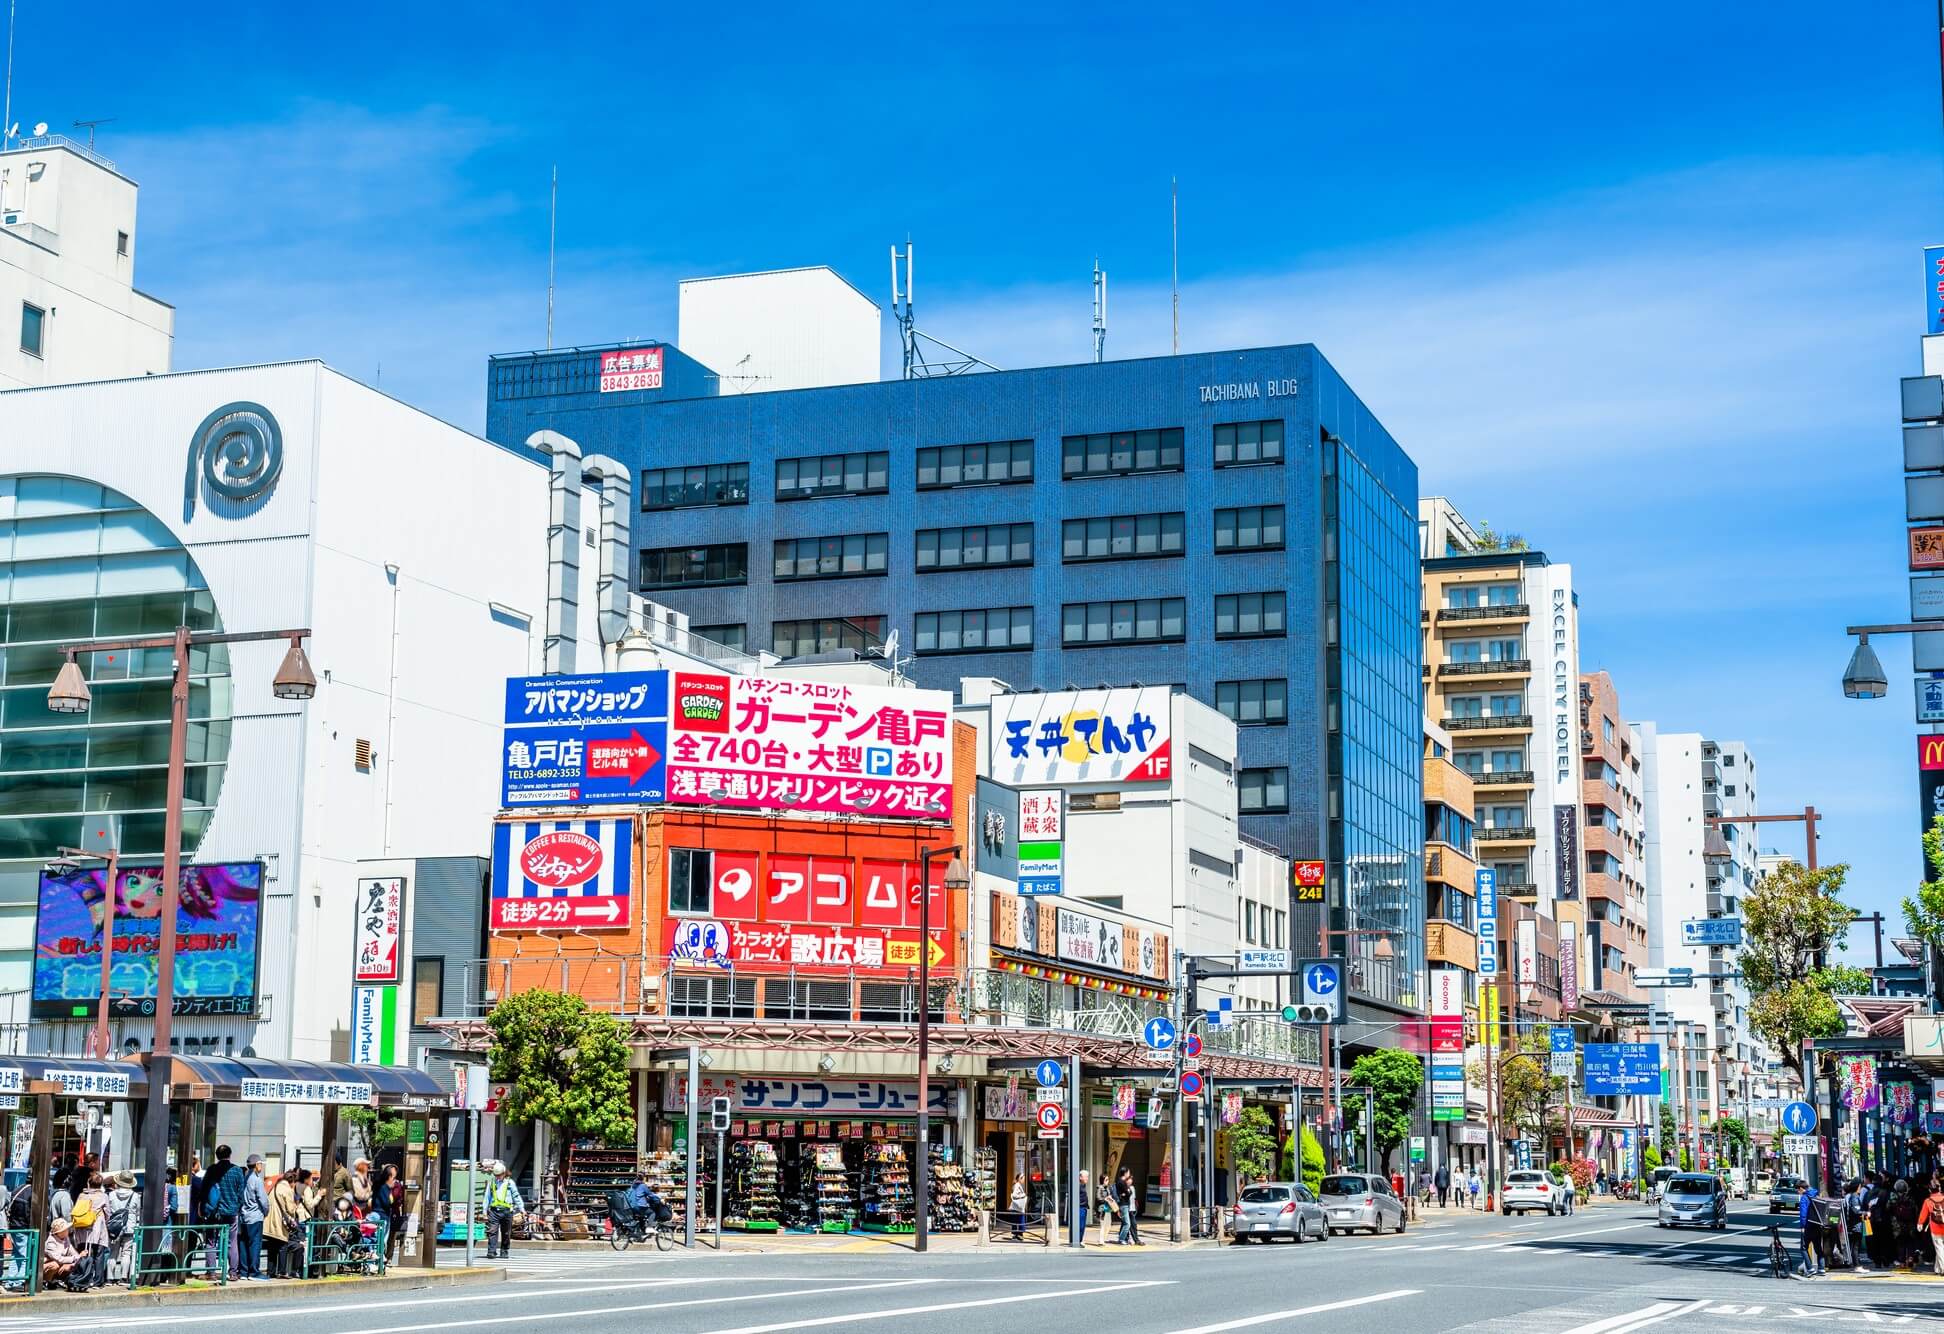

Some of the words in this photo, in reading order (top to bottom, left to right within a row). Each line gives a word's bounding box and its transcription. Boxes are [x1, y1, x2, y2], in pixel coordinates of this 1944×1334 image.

[604, 354, 660, 374] 広告募集
[1200, 382, 1260, 402] TACHIBANA
[1268, 379, 1297, 397] BLDG
[1553, 589, 1566, 657] EXCEL
[738, 678, 852, 700] パチンコ・スロット
[1555, 660, 1568, 710] CITY
[525, 684, 648, 715] アパマンショップ
[681, 695, 723, 711] GARDEN
[684, 707, 720, 720] GARDEN
[735, 696, 947, 747] ガーデン亀戸
[508, 739, 583, 769] 亀戸店
[1557, 714, 1569, 784] HOTEL
[1144, 757, 1169, 775] 1F
[671, 769, 947, 812] 浅草通りオリンピック近く
[525, 837, 551, 857] COFFEE
[551, 835, 557, 844] &
[558, 833, 600, 855] RESTAURANT
[1020, 863, 1058, 872] FamilyMart
[770, 872, 898, 908] アコム
[501, 900, 571, 923] 徒歩2分
[733, 930, 790, 947] カラオケ
[790, 932, 884, 966] 歌広場
[740, 947, 783, 962] ルーム
[1244, 952, 1285, 962] 亀戸駅北口
[361, 989, 374, 1063] FamilyMart
